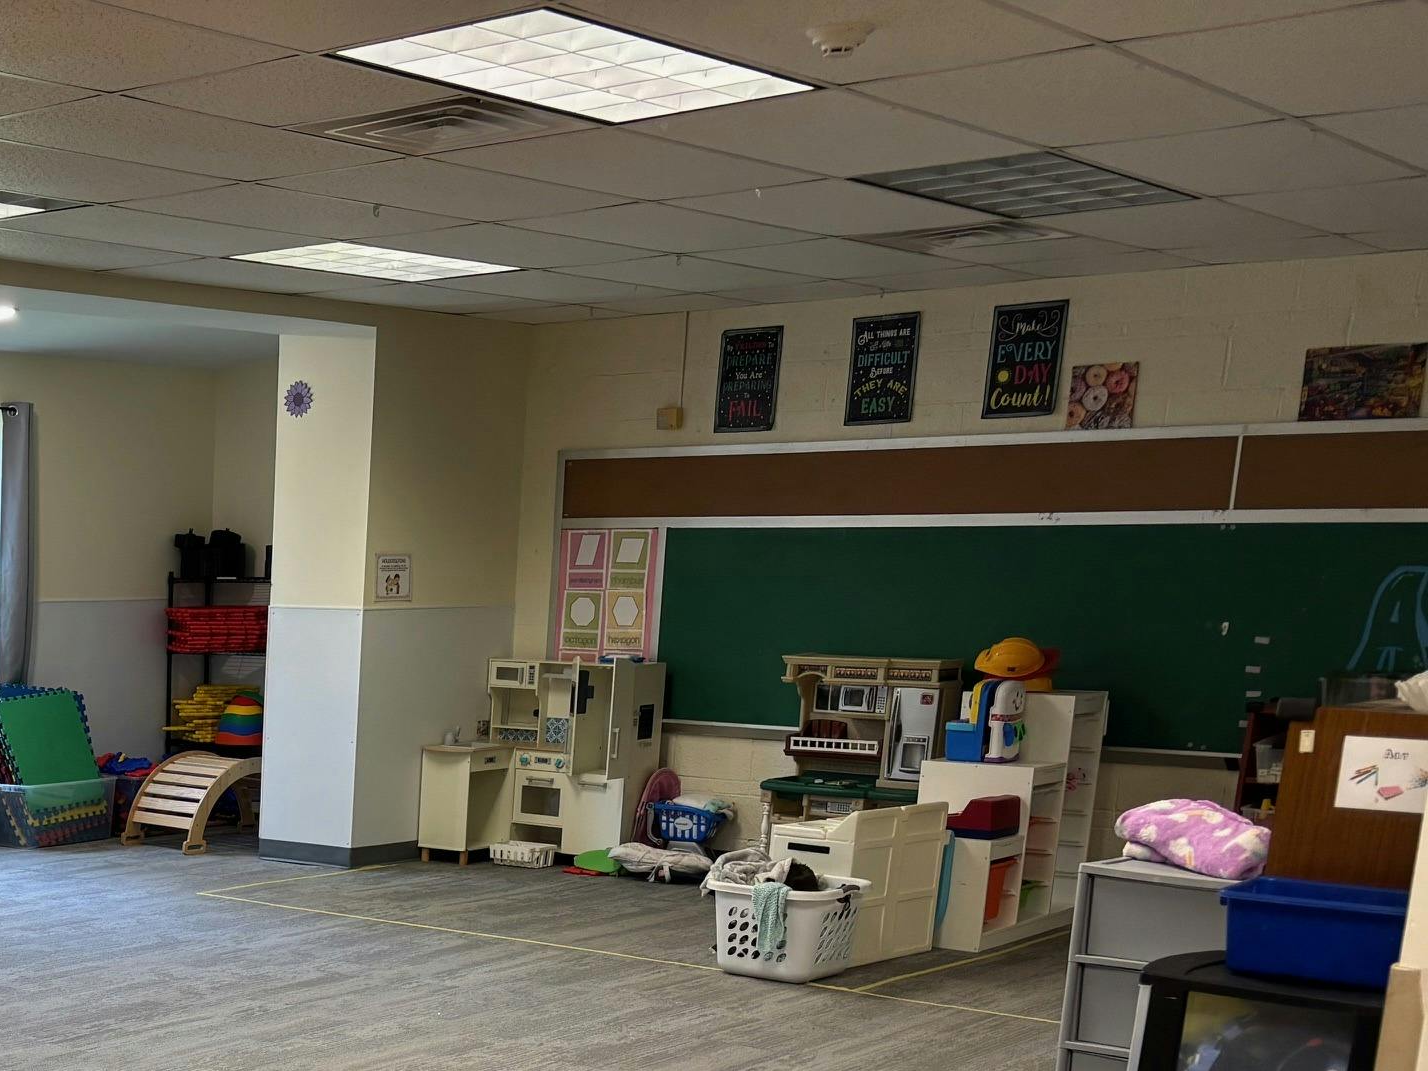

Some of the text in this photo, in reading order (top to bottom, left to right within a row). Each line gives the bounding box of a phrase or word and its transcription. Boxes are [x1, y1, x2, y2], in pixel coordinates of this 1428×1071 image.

[1015, 320, 1043, 335] Make
[857, 351, 910, 367] DIFFICULT
[997, 340, 1056, 363] EVERY
[736, 370, 764, 380] You Are
[1014, 362, 1052, 385] DAY
[853, 379, 909, 398] THEY ARE
[728, 400, 762, 423] FAIL
[860, 396, 895, 414] EASY
